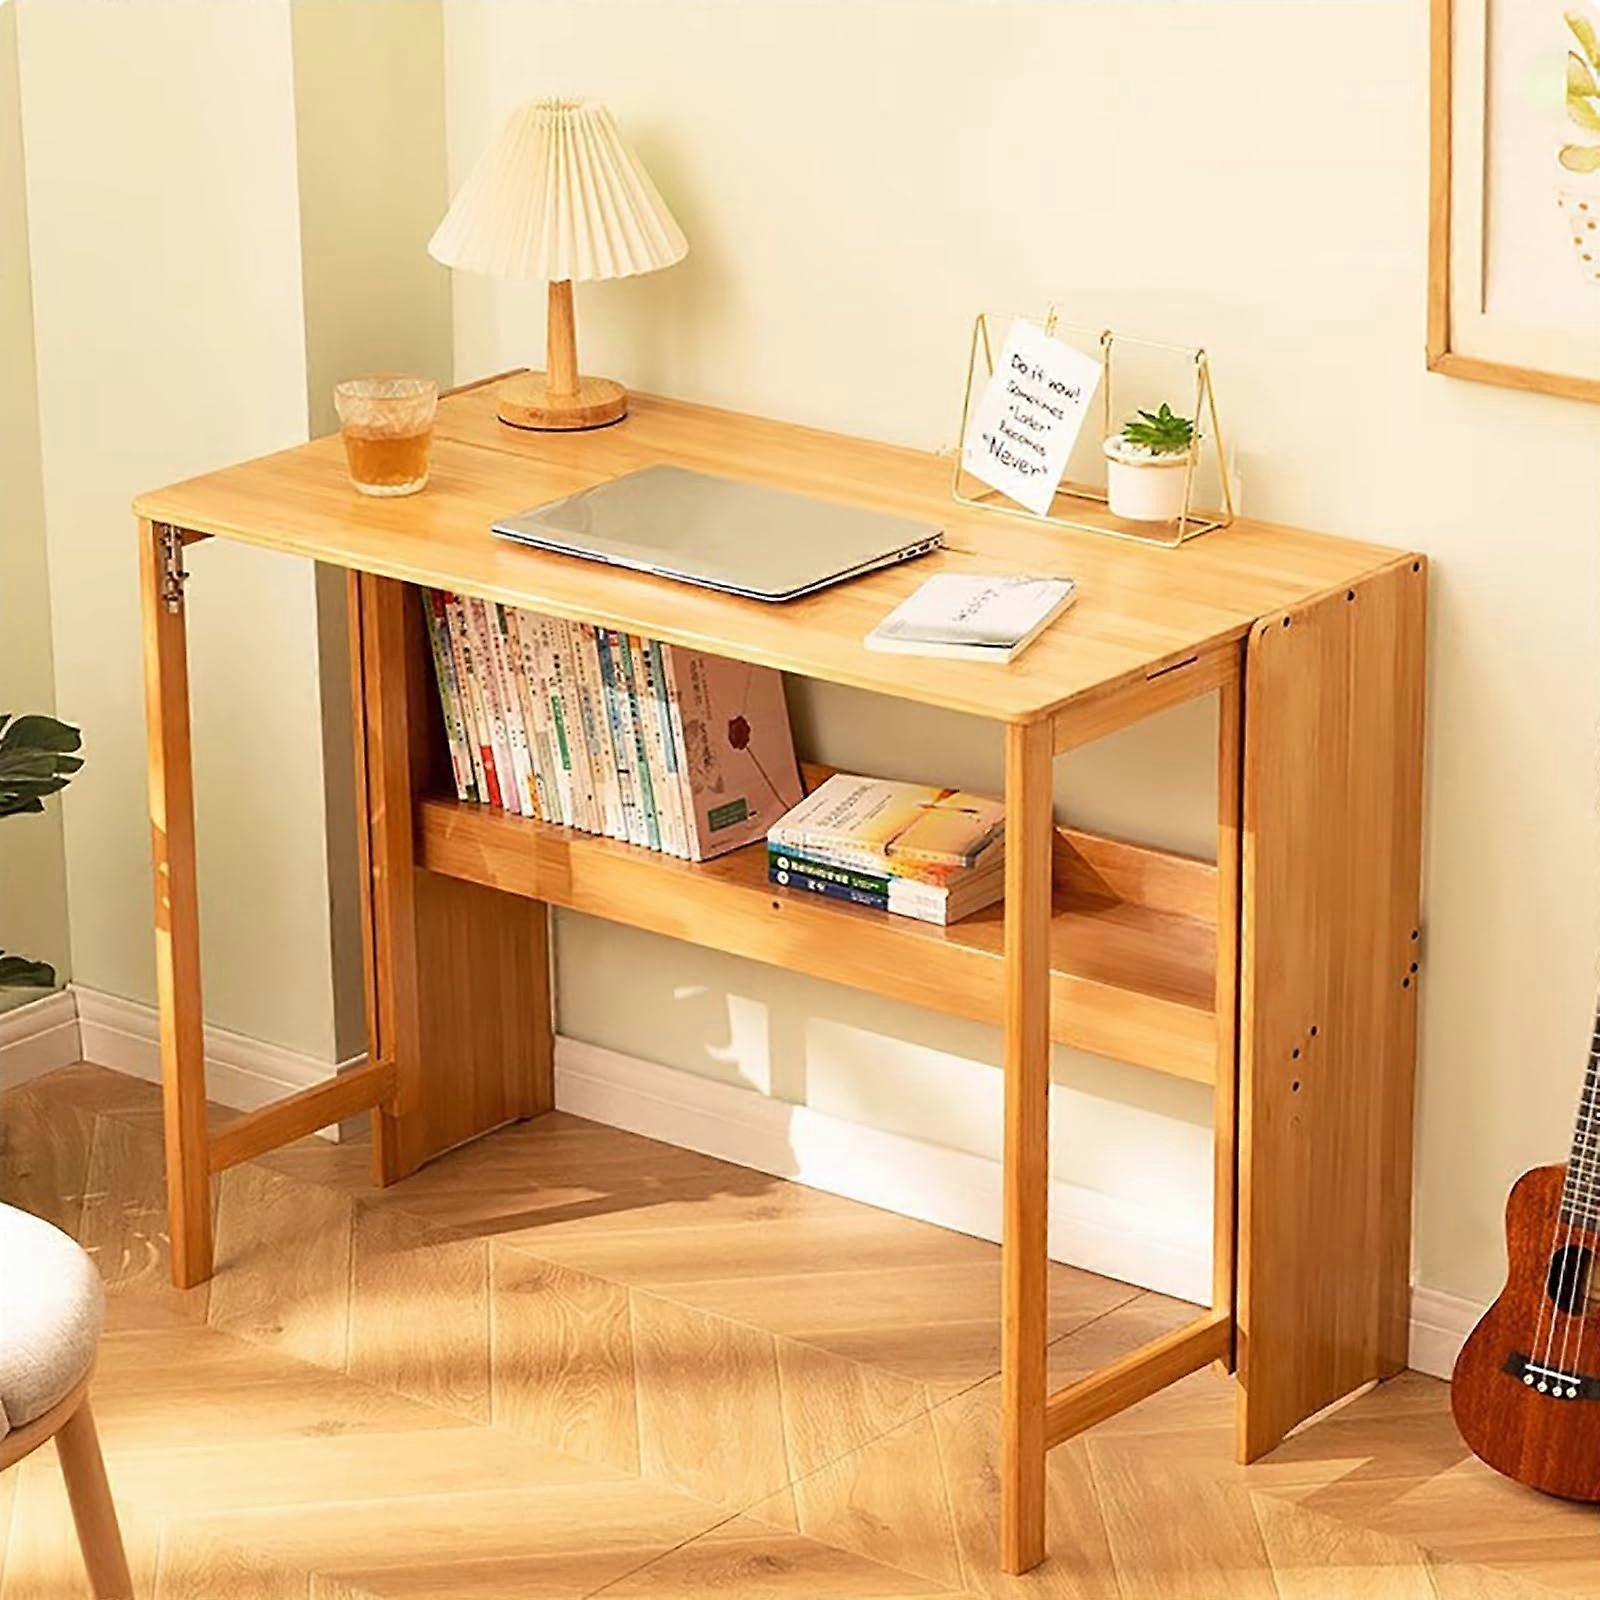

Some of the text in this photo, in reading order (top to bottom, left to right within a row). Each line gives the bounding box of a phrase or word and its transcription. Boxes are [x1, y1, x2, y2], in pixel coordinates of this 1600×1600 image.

[1011, 353, 1081, 404] Do it now!
